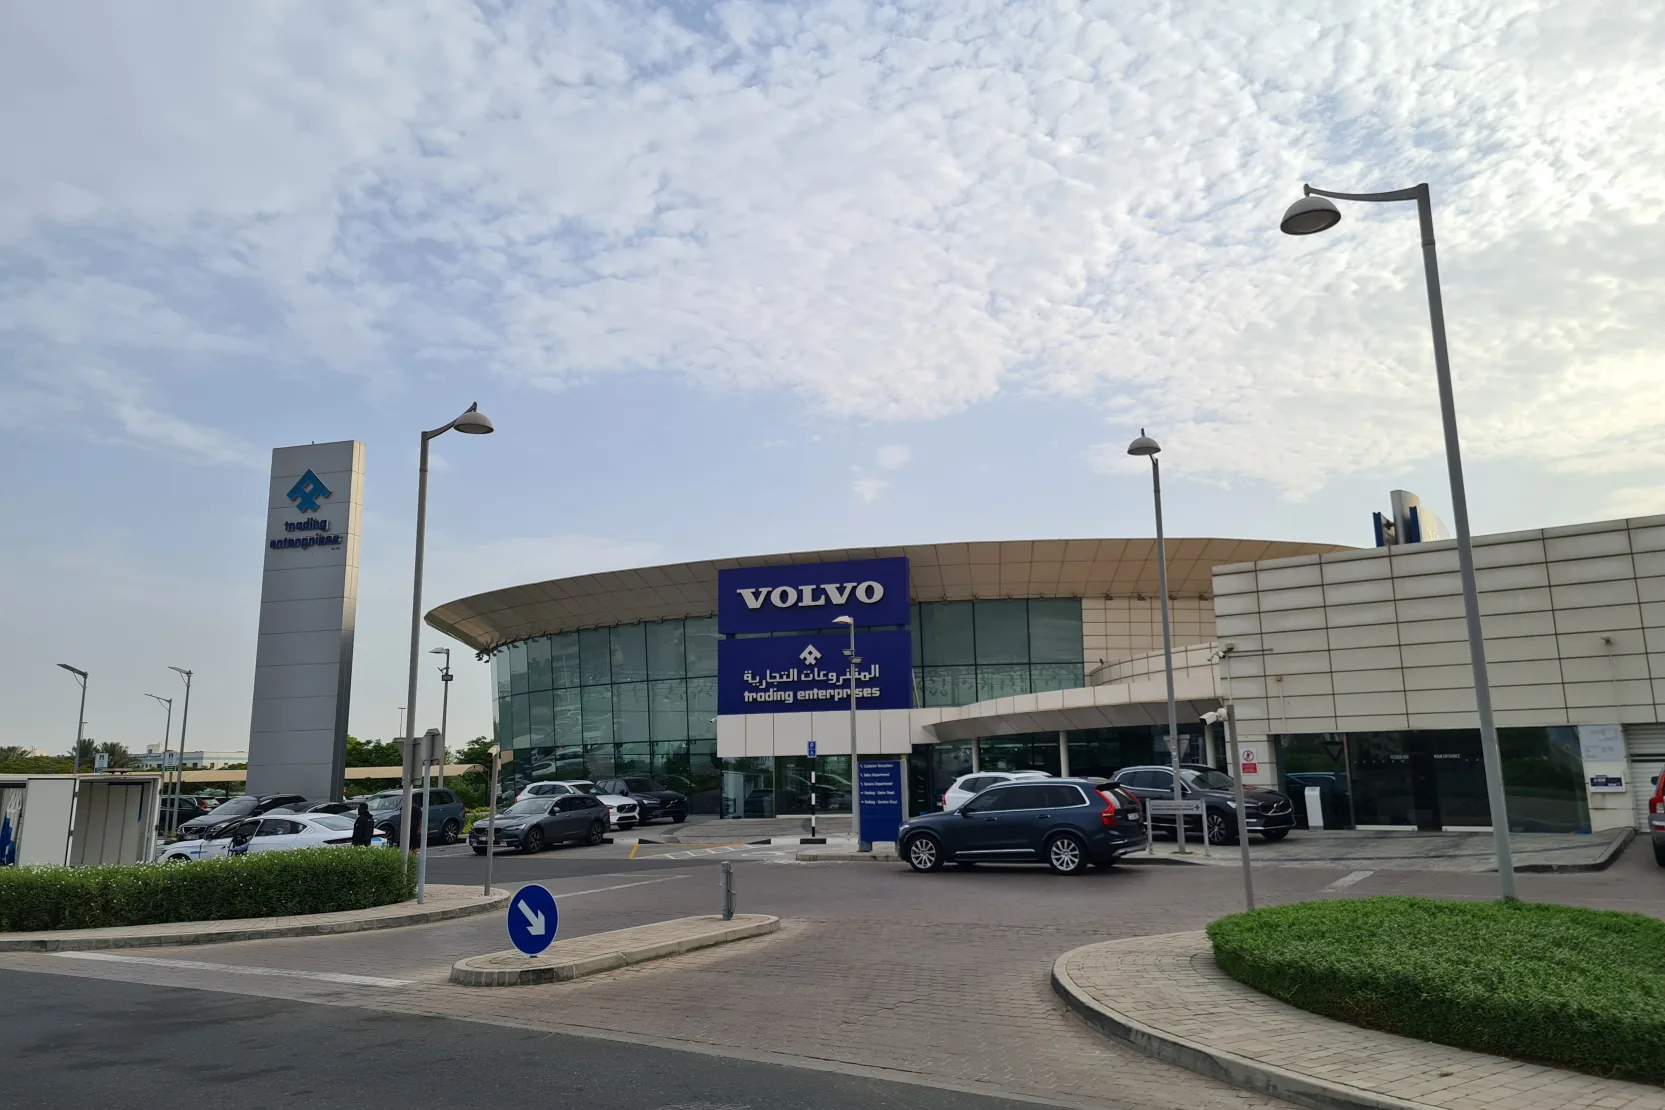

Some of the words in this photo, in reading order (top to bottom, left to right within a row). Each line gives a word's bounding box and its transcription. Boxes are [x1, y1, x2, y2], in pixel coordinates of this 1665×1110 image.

[284, 517, 329, 532] trading
[737, 581, 884, 609] VOLVO
[744, 668, 798, 689] التجارية
[744, 688, 794, 704] trading
[797, 687, 881, 702] enterprses
